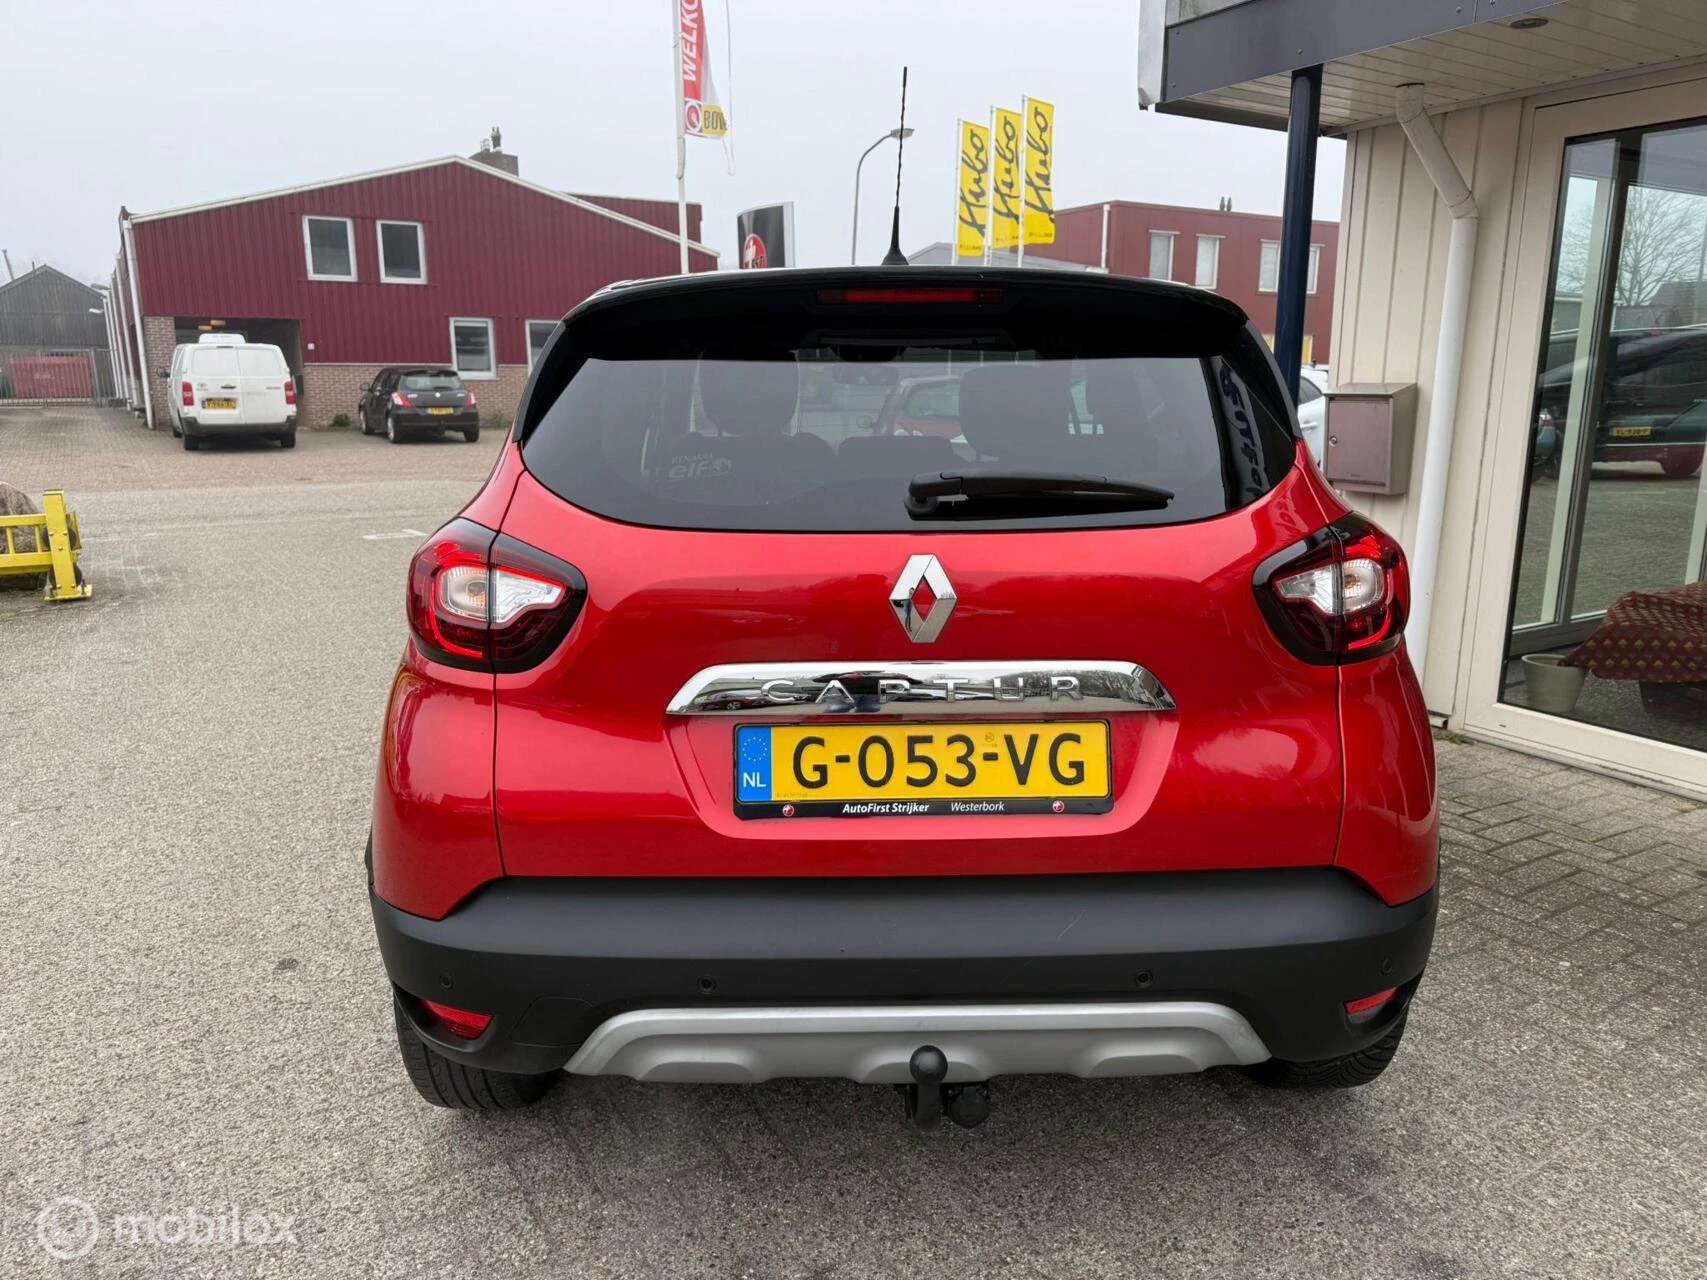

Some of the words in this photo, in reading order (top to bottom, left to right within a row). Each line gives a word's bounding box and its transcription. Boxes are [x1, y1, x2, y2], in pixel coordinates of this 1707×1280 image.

[760, 678, 1085, 704] CAPTUR
[792, 732, 1086, 789] G-053-VG
[742, 771, 767, 789] NL
[842, 803, 890, 815] AutoFirst
[892, 802, 930, 816] Strijker
[950, 801, 1005, 813] Westerbork
